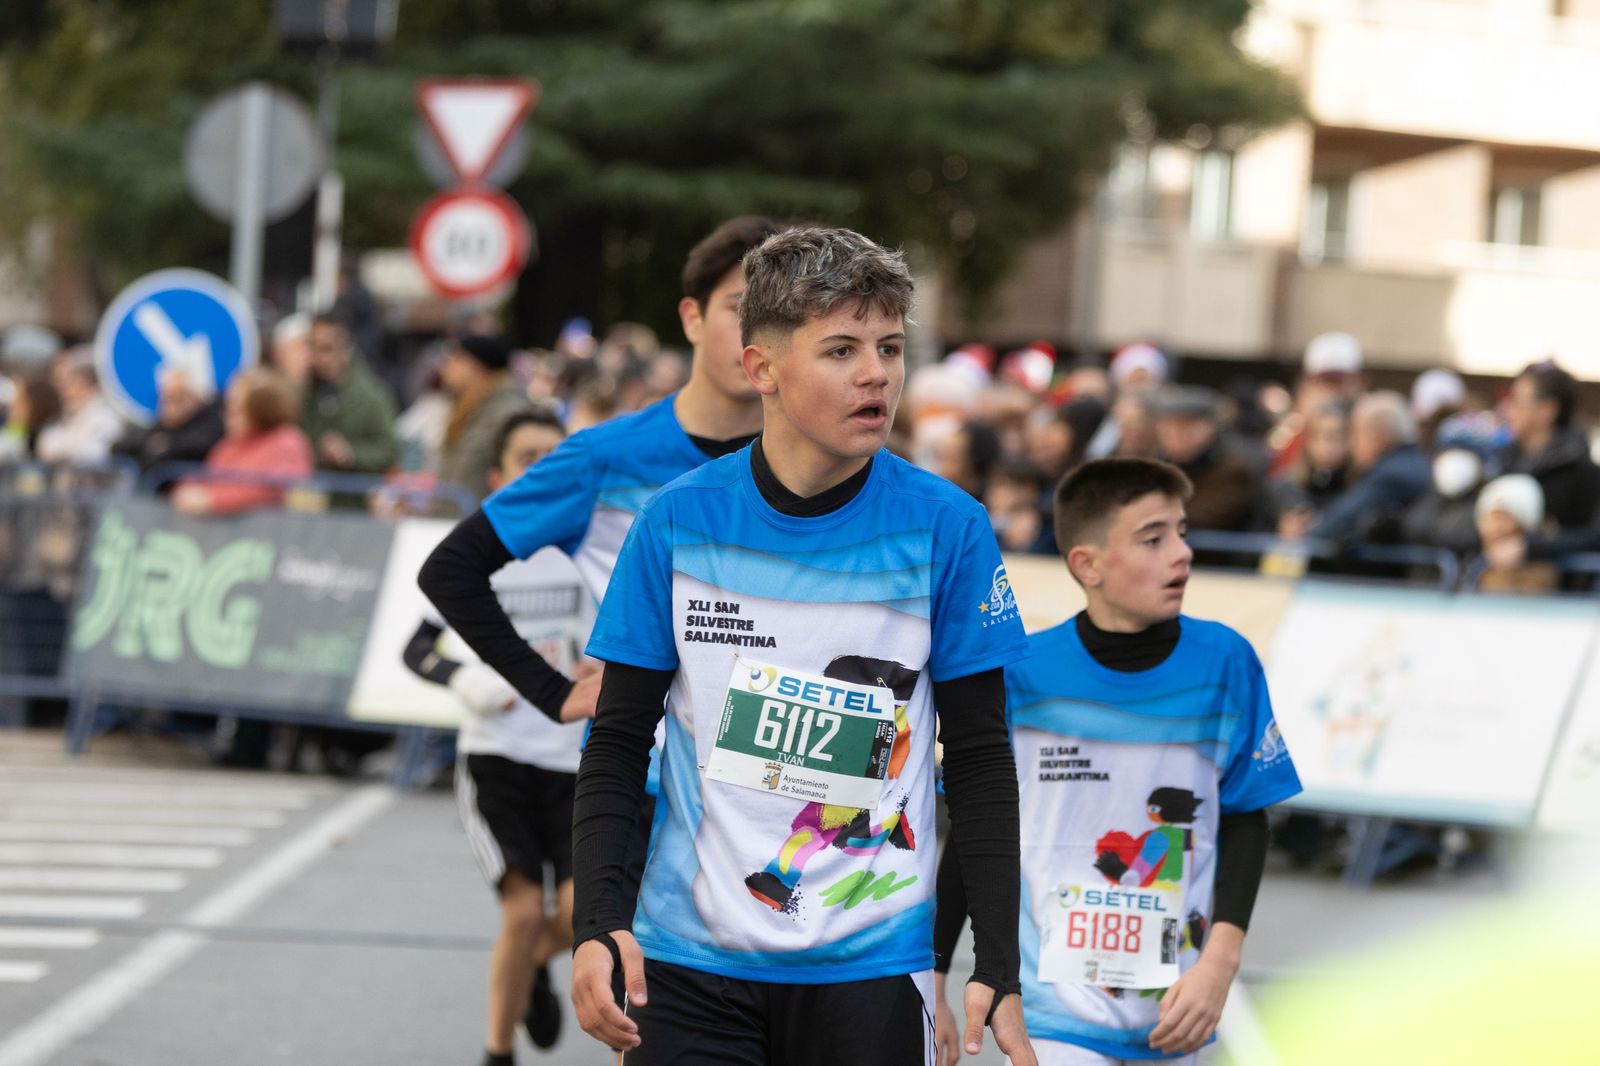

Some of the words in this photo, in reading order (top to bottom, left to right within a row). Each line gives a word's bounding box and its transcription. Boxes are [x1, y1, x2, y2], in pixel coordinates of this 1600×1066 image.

[687, 600, 711, 612] XLI
[714, 602, 740, 614] SAN
[686, 615, 755, 631] SILVESTRE
[684, 630, 777, 648] SALMANTINA
[777, 675, 882, 714] SETEL
[753, 699, 842, 762] 6112
[776, 752, 805, 767] IVAN
[784, 774, 829, 791] Ayuntamiento
[781, 784, 790, 792] de
[791, 786, 827, 799] Salamanca
[1084, 890, 1167, 912] SETEL
[1067, 911, 1142, 954] 6188
